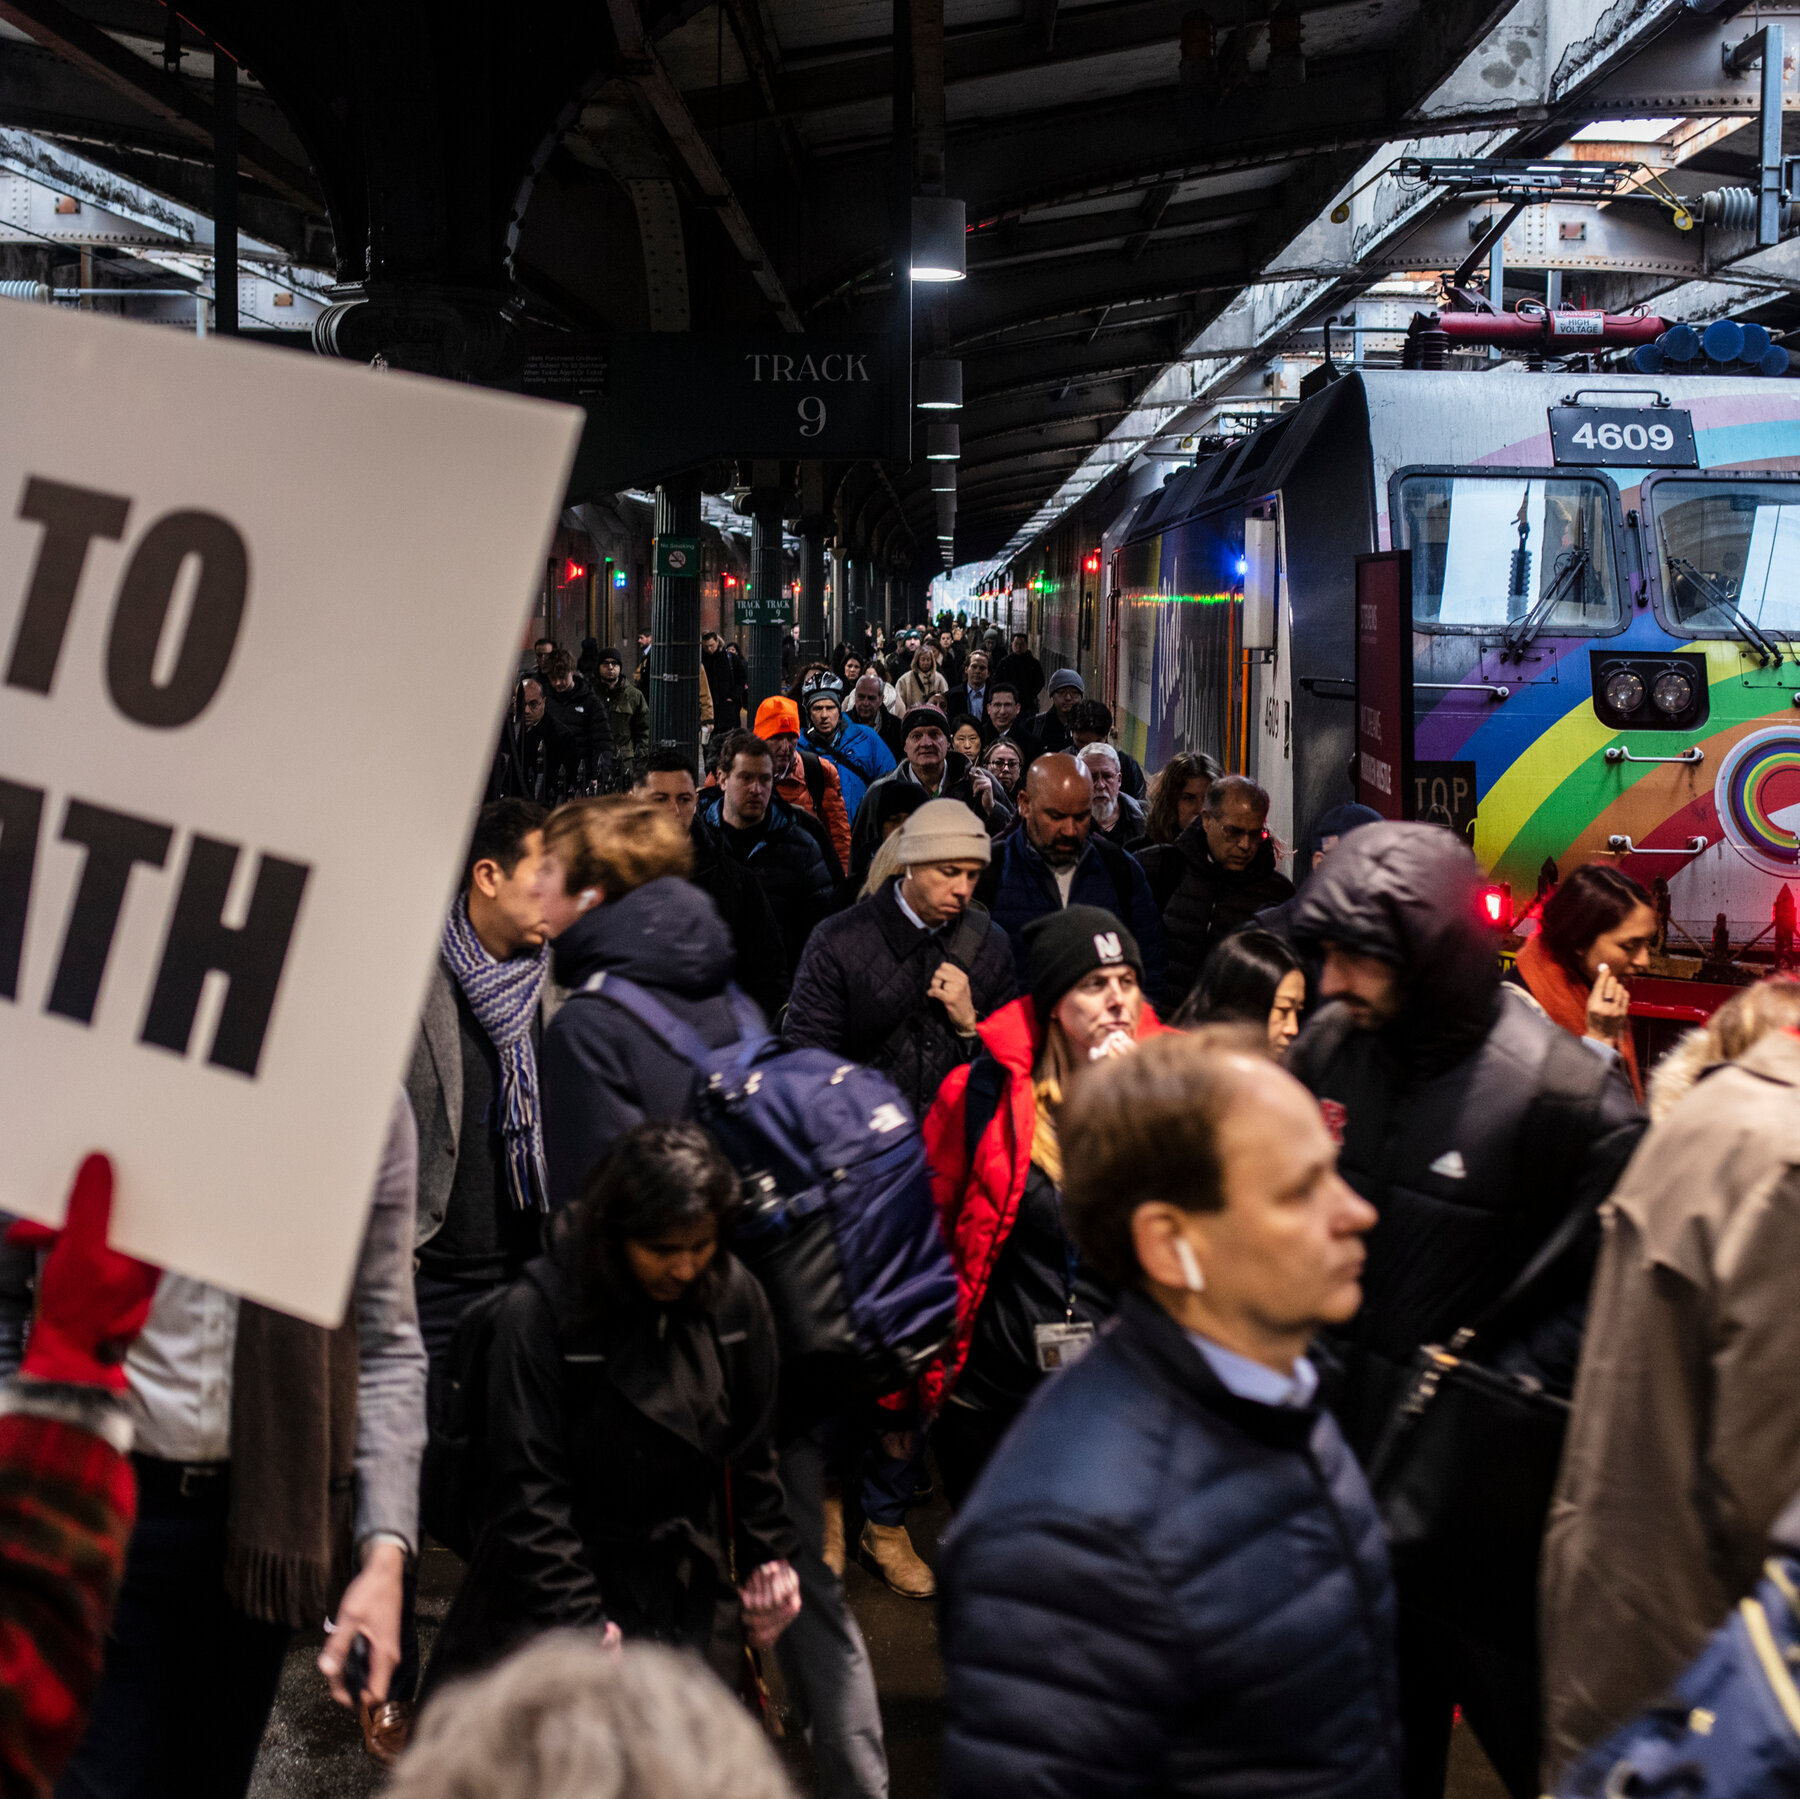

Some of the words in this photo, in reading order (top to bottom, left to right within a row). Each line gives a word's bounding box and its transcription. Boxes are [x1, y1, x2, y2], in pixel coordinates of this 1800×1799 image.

[1560, 326, 1599, 334] VOLTAGE
[1568, 318, 1590, 326] HIGH
[744, 353, 872, 383] TRACK
[797, 396, 828, 438] 9
[1572, 423, 1675, 451] 4609
[4, 474, 250, 733] TO
[736, 599, 761, 609] TRACK
[766, 599, 790, 609] TRACK
[745, 609, 754, 618] 10
[775, 609, 781, 618] 9
[1264, 696, 1280, 739] 4609
[1414, 776, 1469, 815] TOP
[0, 776, 312, 1080] ATH
